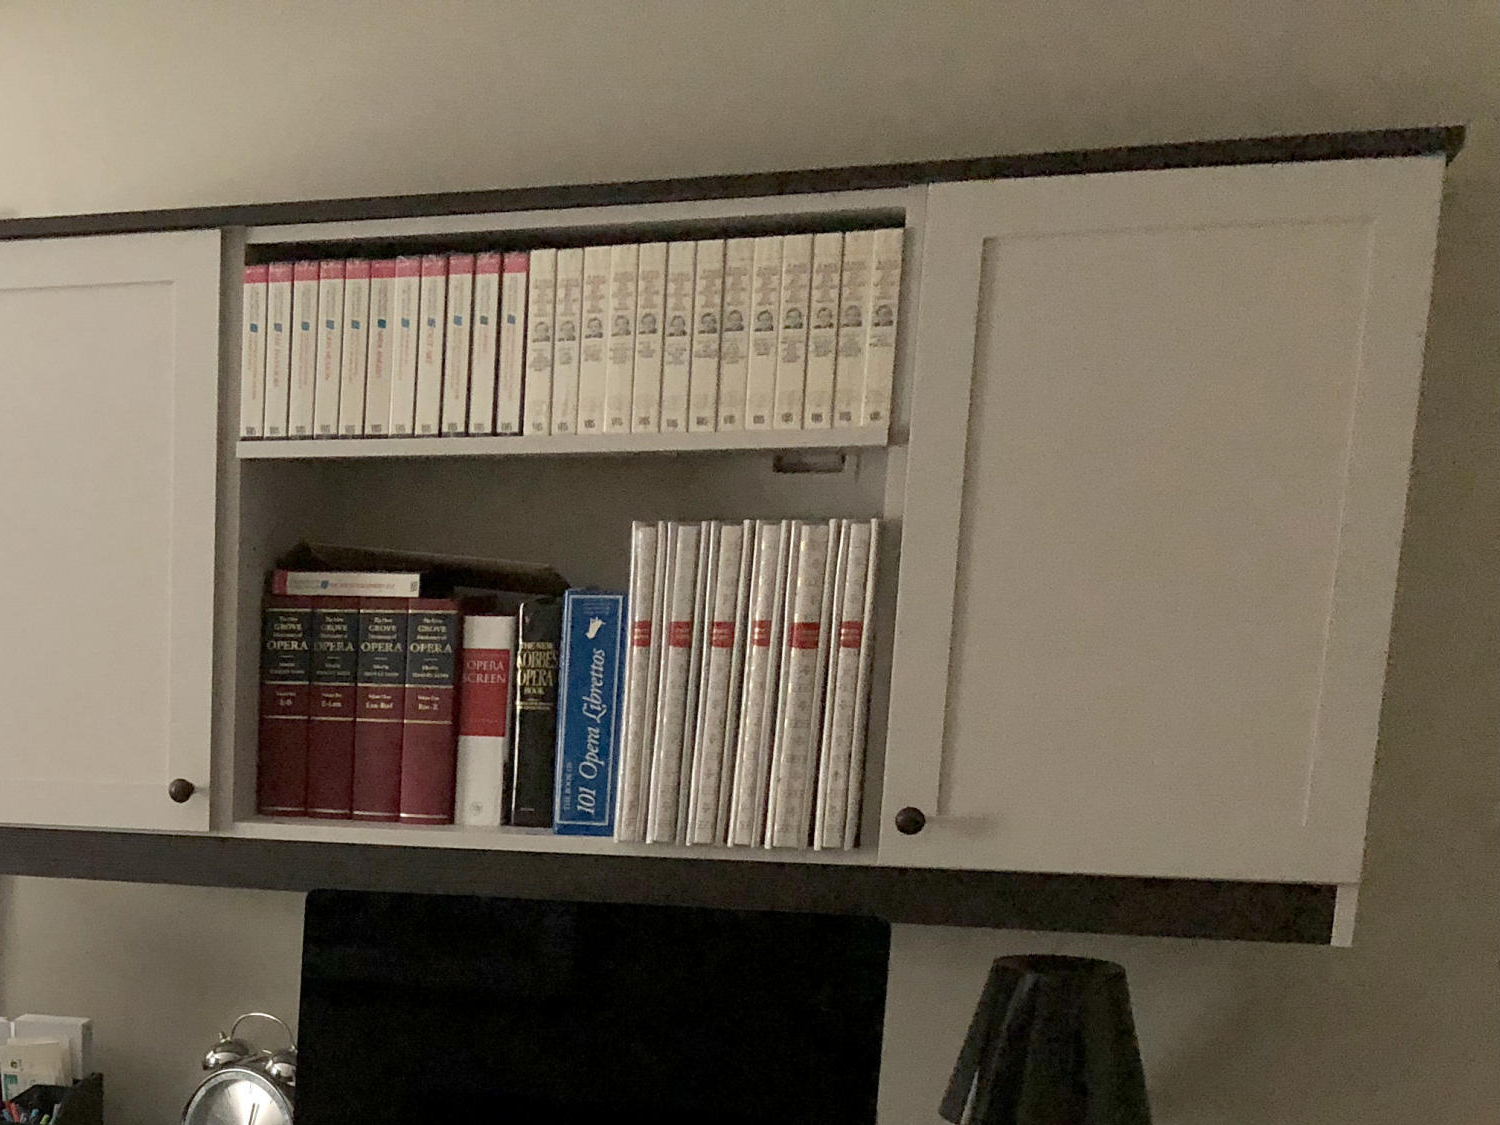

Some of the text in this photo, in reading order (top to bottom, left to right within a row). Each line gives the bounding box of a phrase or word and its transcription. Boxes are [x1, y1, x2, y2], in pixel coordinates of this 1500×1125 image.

[266, 640, 309, 650] OPERA
[314, 641, 355, 652] OPERA
[360, 642, 403, 652] OPERA
[410, 643, 452, 653] OPERA
[467, 660, 504, 671] OPERA
[463, 672, 506, 684] SCREEN
[520, 669, 553, 687] OPERA
[581, 647, 608, 724] Librettos
[579, 726, 605, 779] Opera
[577, 786, 597, 815] 101
